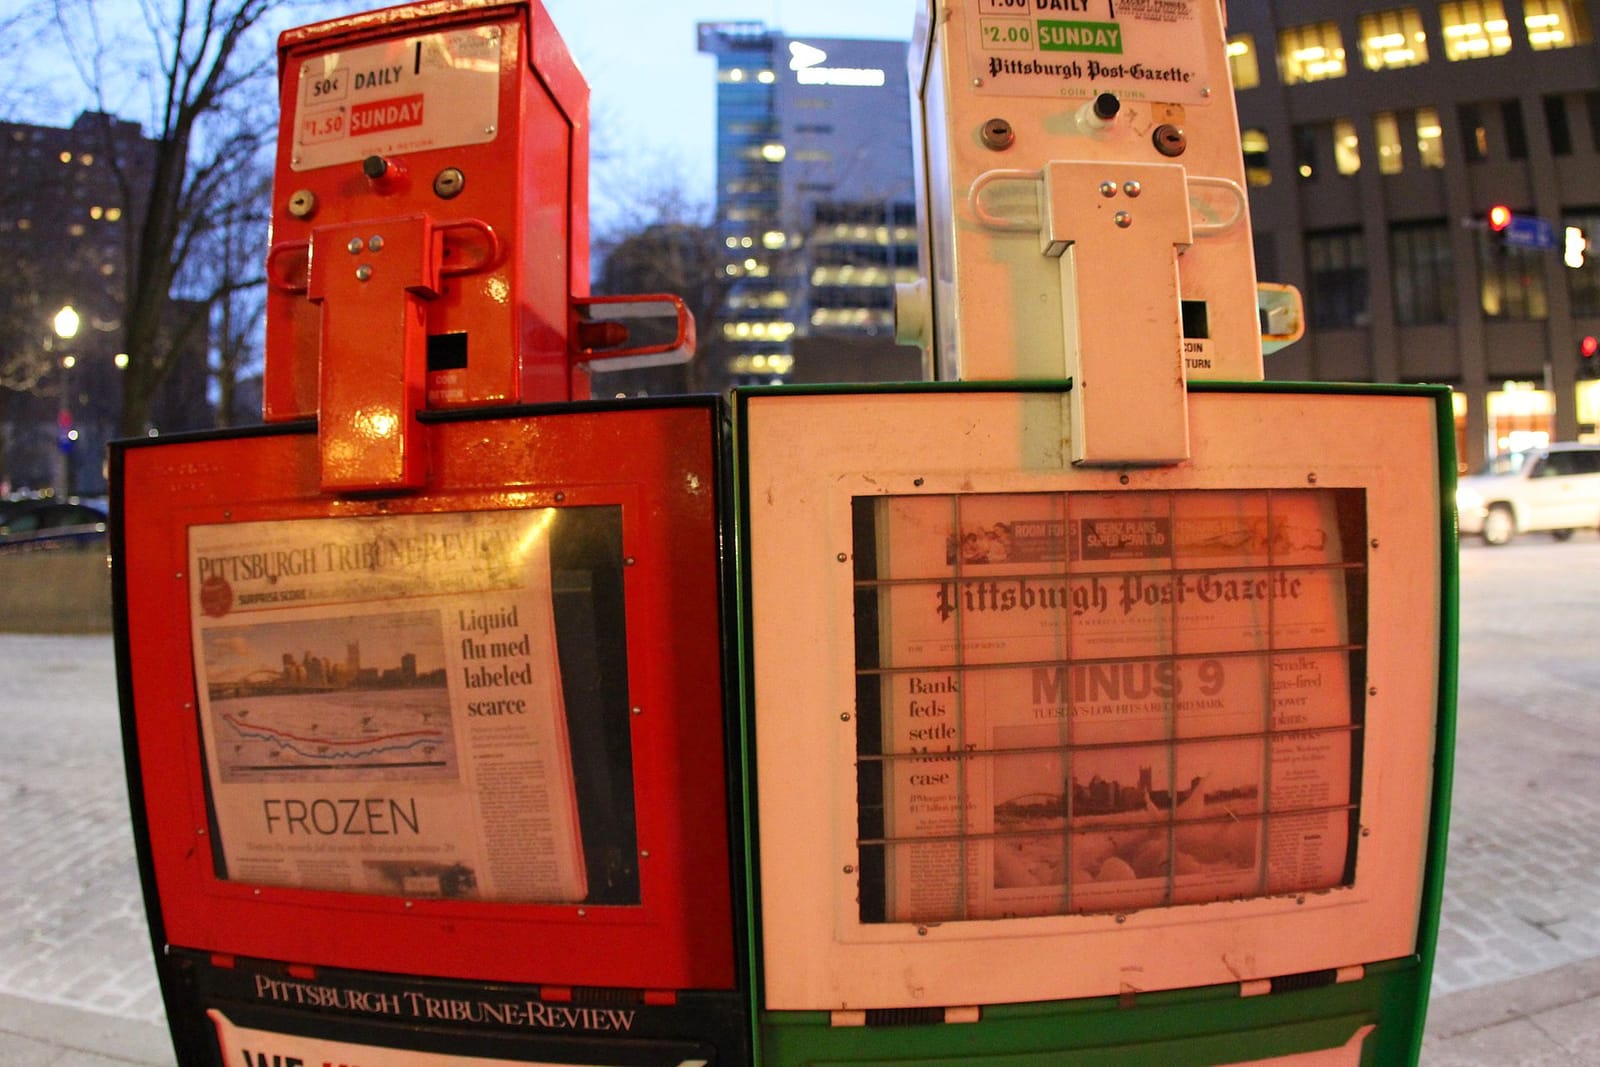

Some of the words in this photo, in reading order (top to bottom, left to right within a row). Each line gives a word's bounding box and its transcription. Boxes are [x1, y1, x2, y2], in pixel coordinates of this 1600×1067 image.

[984, 26, 1030, 43] $2.00
[1039, 26, 1119, 48] SUNDAY
[353, 65, 402, 90] DAILY
[989, 57, 1082, 79] Pittsburgh
[1087, 60, 1191, 83] Post-Gazette
[351, 102, 422, 131] SUNDAY
[1014, 524, 1046, 538] ROOM
[198, 548, 316, 585] PITTSBURGH
[937, 577, 1108, 622] Pittsburgh
[1120, 571, 1301, 615] Post-Gazette
[459, 605, 519, 635] Liquid
[462, 638, 487, 660] flu
[490, 633, 531, 658] med
[464, 663, 533, 689] labeled
[909, 676, 959, 695] Bank
[1032, 663, 1183, 705] MINUS
[1198, 659, 1226, 697] 9
[467, 698, 526, 717] scarce
[909, 700, 946, 718] feds
[908, 723, 957, 741] settle
[909, 772, 949, 786] case
[263, 798, 420, 836] FROZEN
[254, 974, 401, 1015] PITTSBURGH
[403, 991, 635, 1032] TRIBUNE-REVIEW
